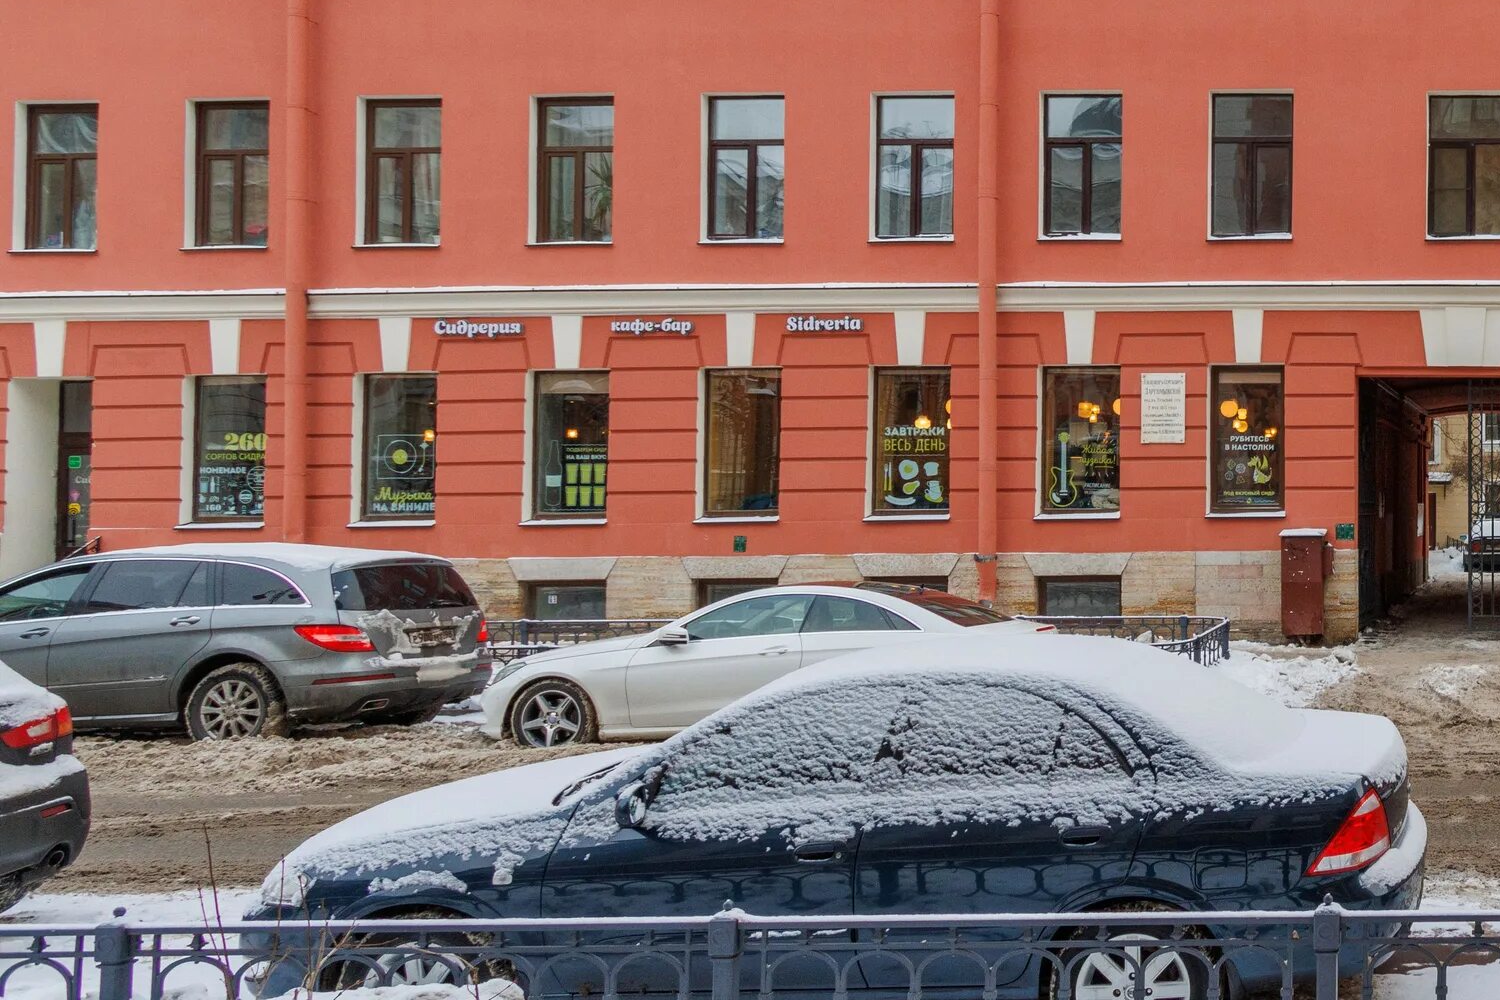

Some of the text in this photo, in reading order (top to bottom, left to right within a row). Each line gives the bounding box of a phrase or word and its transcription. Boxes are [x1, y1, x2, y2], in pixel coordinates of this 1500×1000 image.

[434, 319, 522, 338] Сидрерия
[611, 318, 692, 335] кафе-бар
[786, 315, 862, 331] Sidreria
[884, 426, 945, 436] ЗАВТРАКИ
[224, 433, 269, 451] 260
[884, 439, 946, 453] ВЕСЬ ДЕНЬ
[205, 453, 237, 461] СОРТОВ
[200, 466, 246, 474] HOMEMADE
[374, 487, 434, 505] Музыка
[373, 502, 436, 512] НА ВИНИЛЕ
